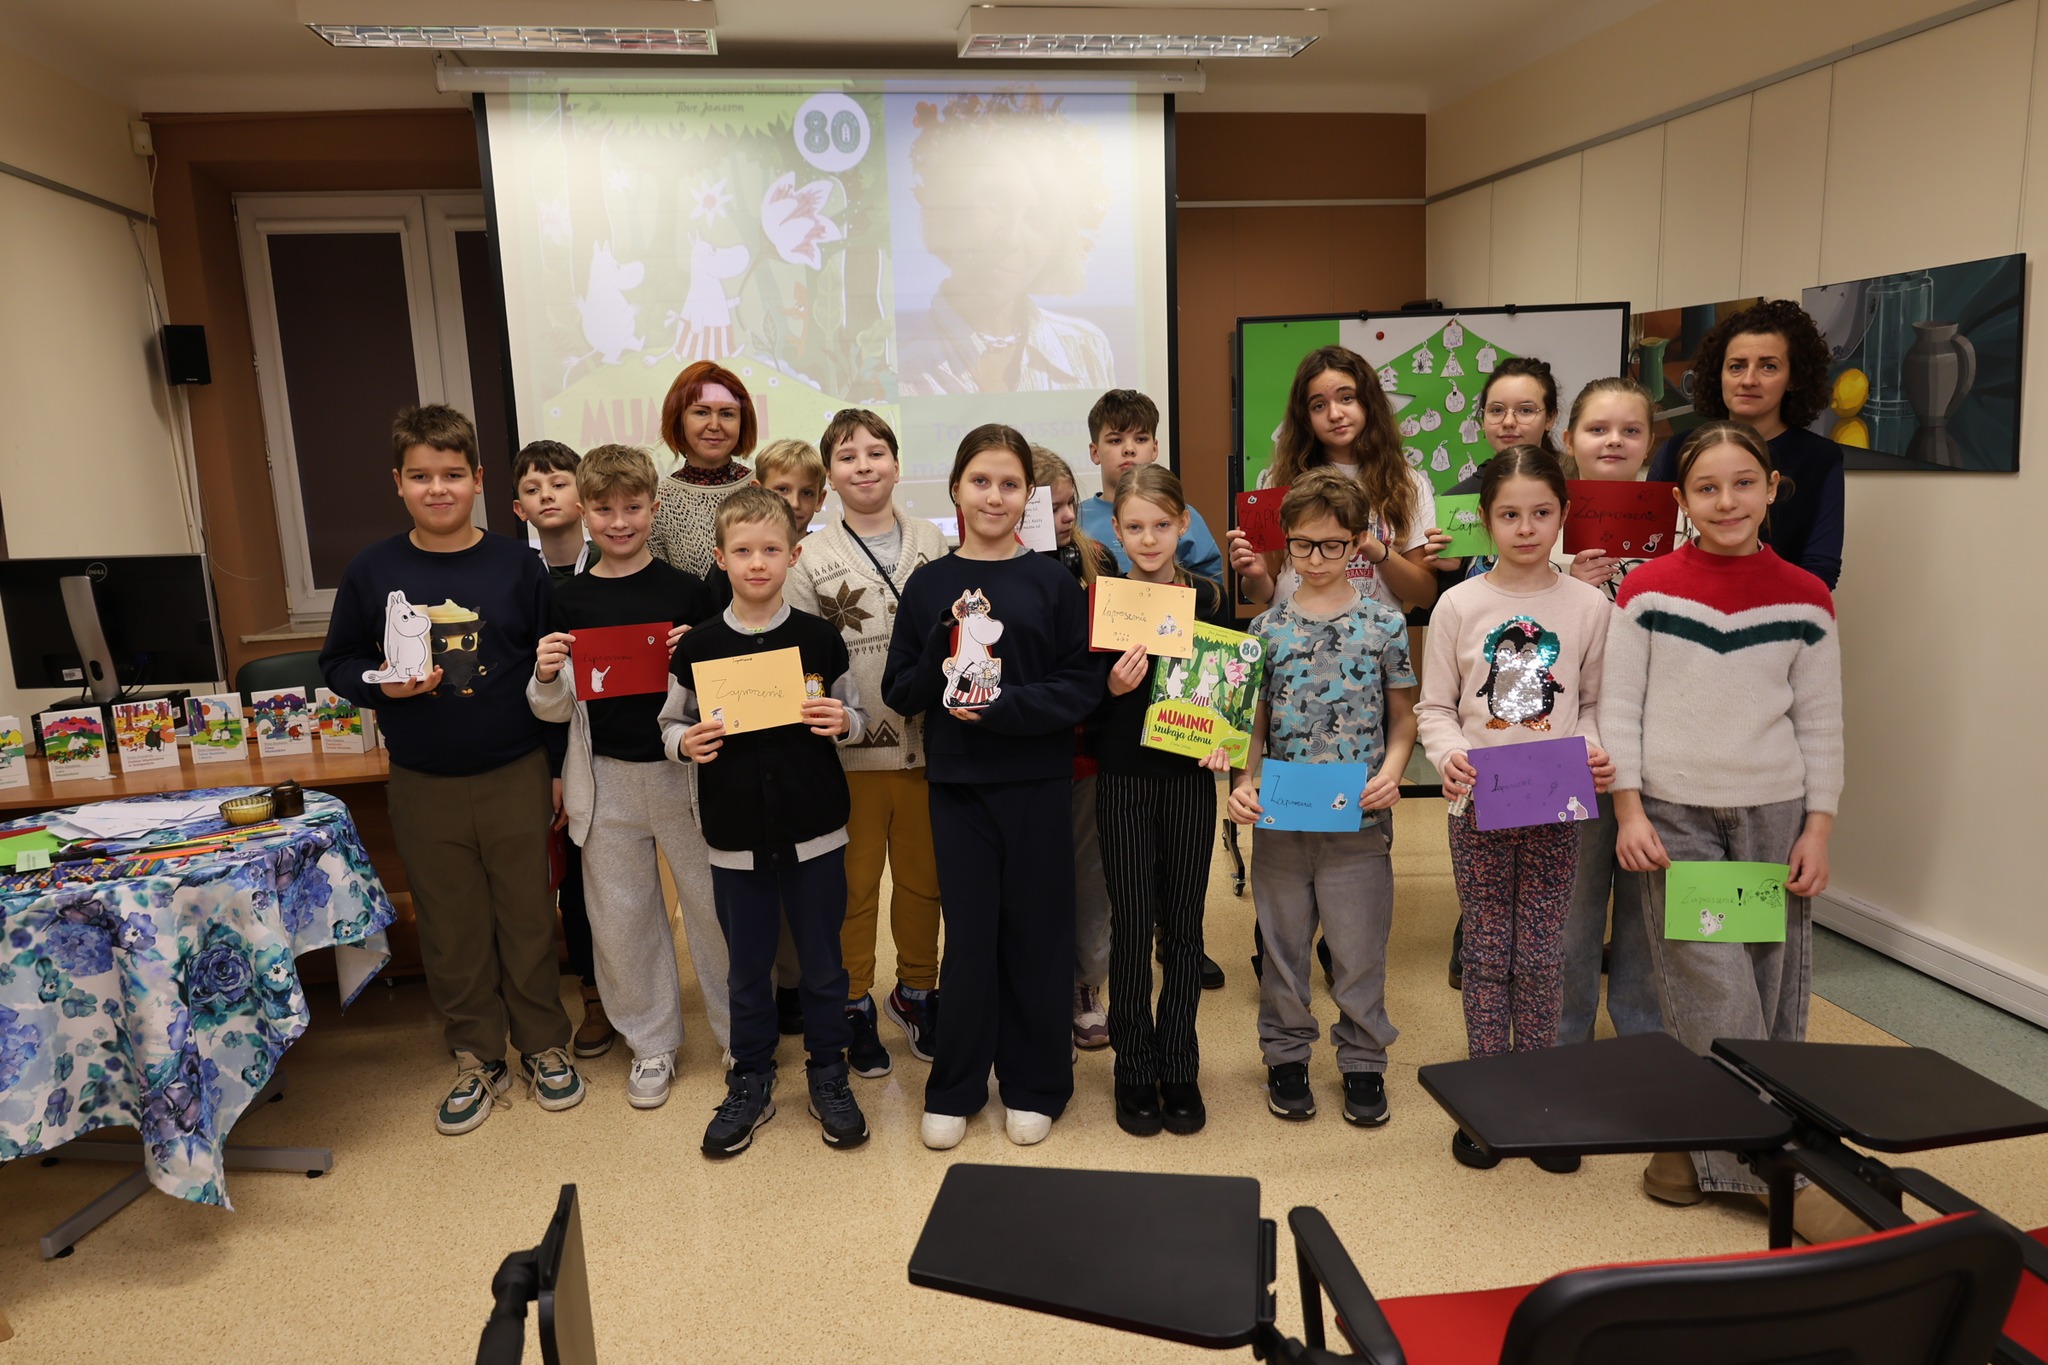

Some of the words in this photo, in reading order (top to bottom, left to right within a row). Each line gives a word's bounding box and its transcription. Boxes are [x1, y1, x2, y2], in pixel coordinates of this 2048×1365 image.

[675, 101, 698, 114] Tove
[700, 101, 745, 117] Jansson
[803, 110, 861, 154] 80
[1241, 642, 1259, 658] 80
[1157, 708, 1215, 734] MUMINKI
[1187, 730, 1213, 746] domu
